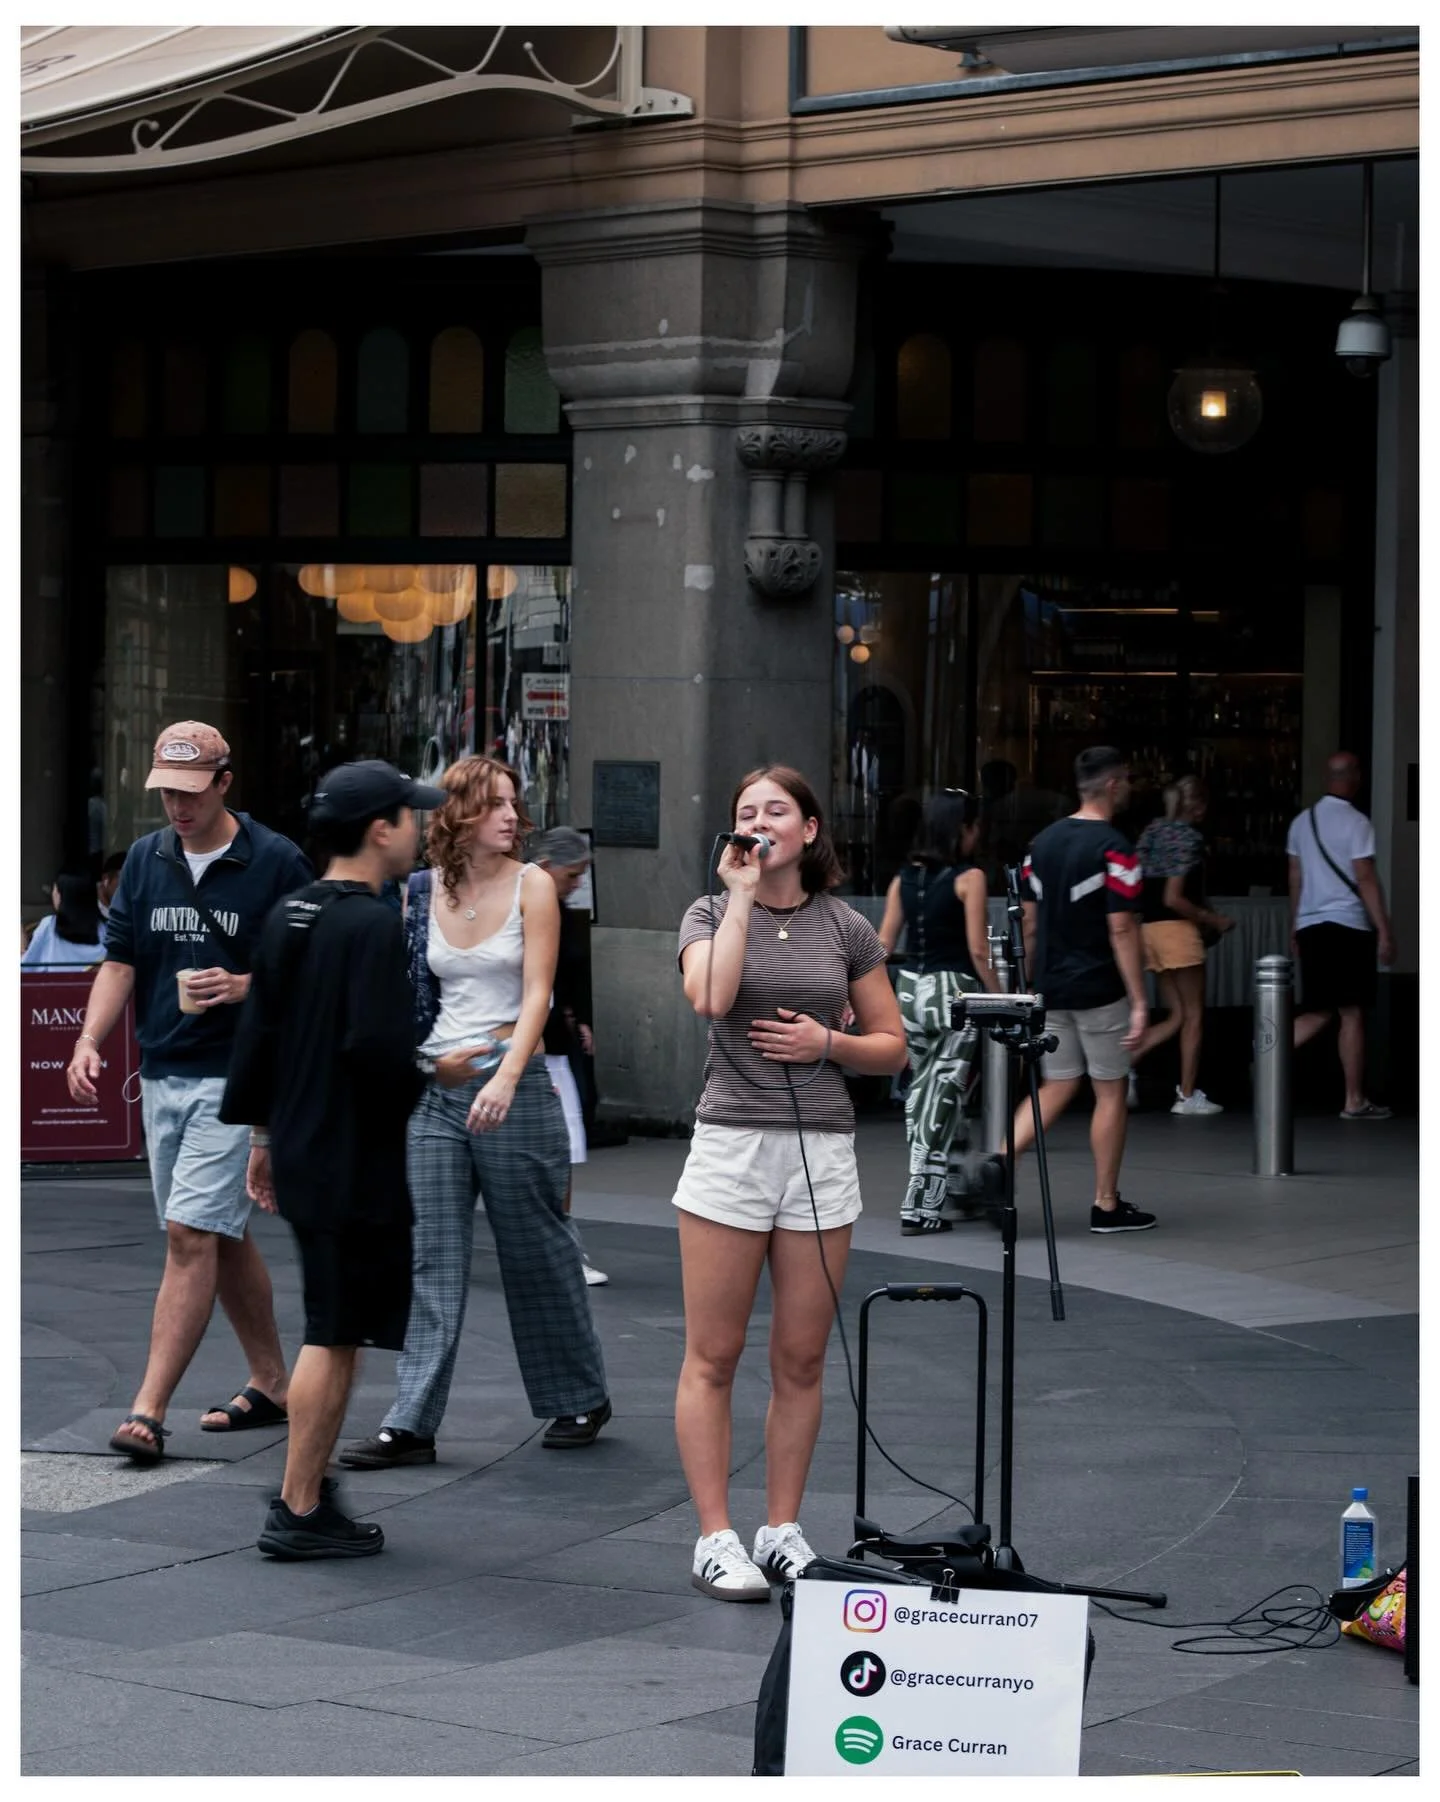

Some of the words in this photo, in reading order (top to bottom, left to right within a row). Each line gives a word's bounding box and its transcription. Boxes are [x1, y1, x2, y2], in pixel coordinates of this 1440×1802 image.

[30, 1061, 64, 1070] NOW
[894, 1605, 1038, 1628] @gracecurran07
[890, 1669, 1034, 1693] @gracecurranyo
[892, 1735, 943, 1752] Grace
[948, 1738, 1007, 1755] Curran
